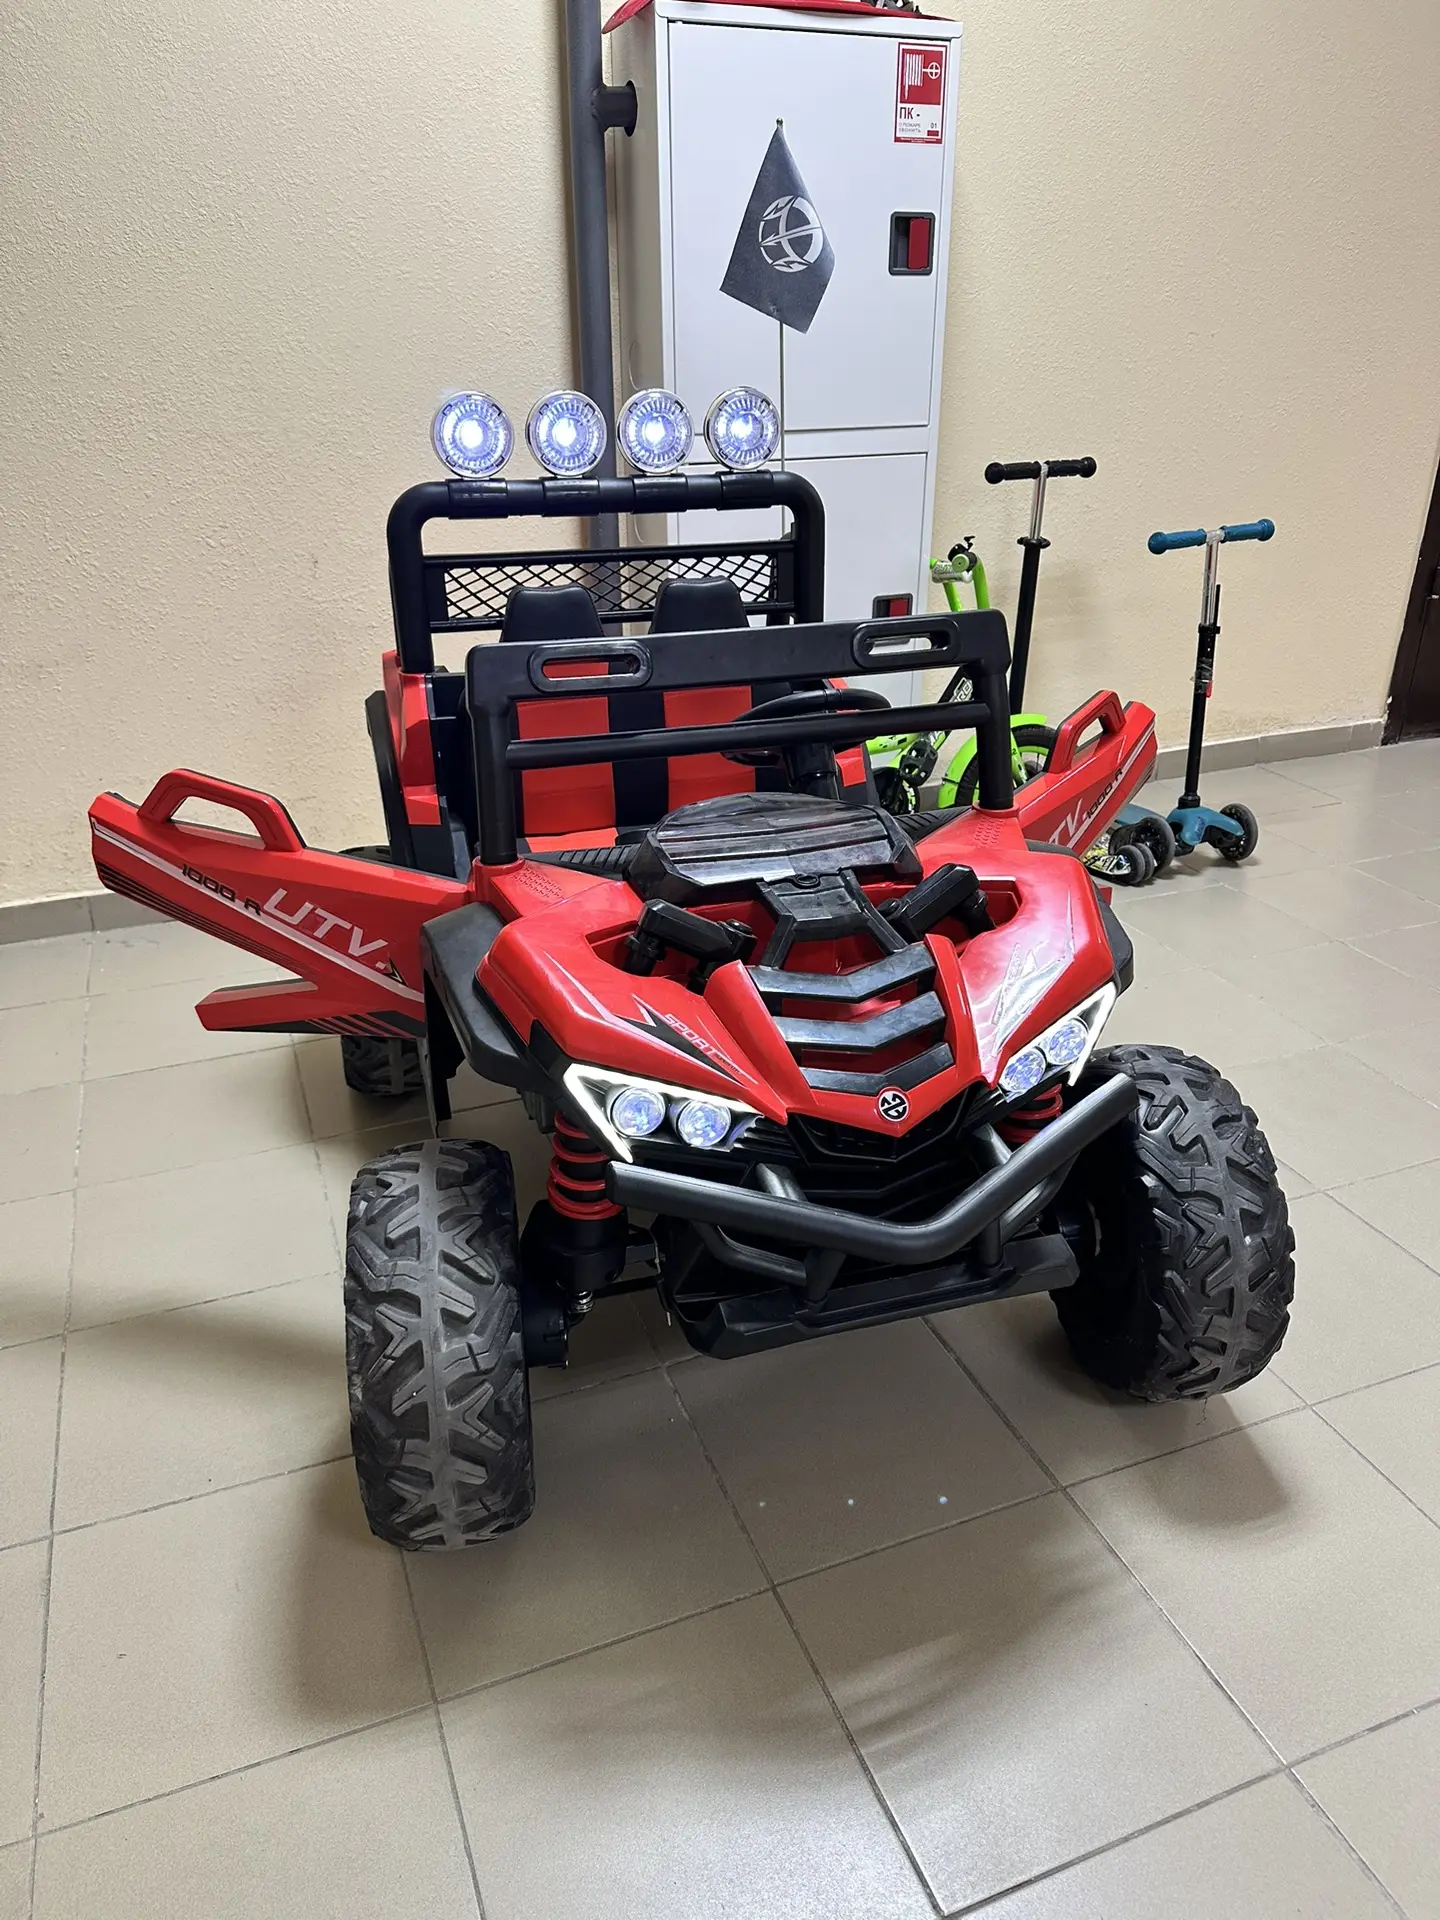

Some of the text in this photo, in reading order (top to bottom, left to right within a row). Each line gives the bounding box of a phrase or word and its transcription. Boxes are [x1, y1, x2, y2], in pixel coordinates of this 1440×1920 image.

[899, 107, 914, 119] ПК
[1086, 767, 1123, 819] 1000 R
[181, 863, 262, 916] 1000 R
[664, 1013, 717, 1057] SPORT
